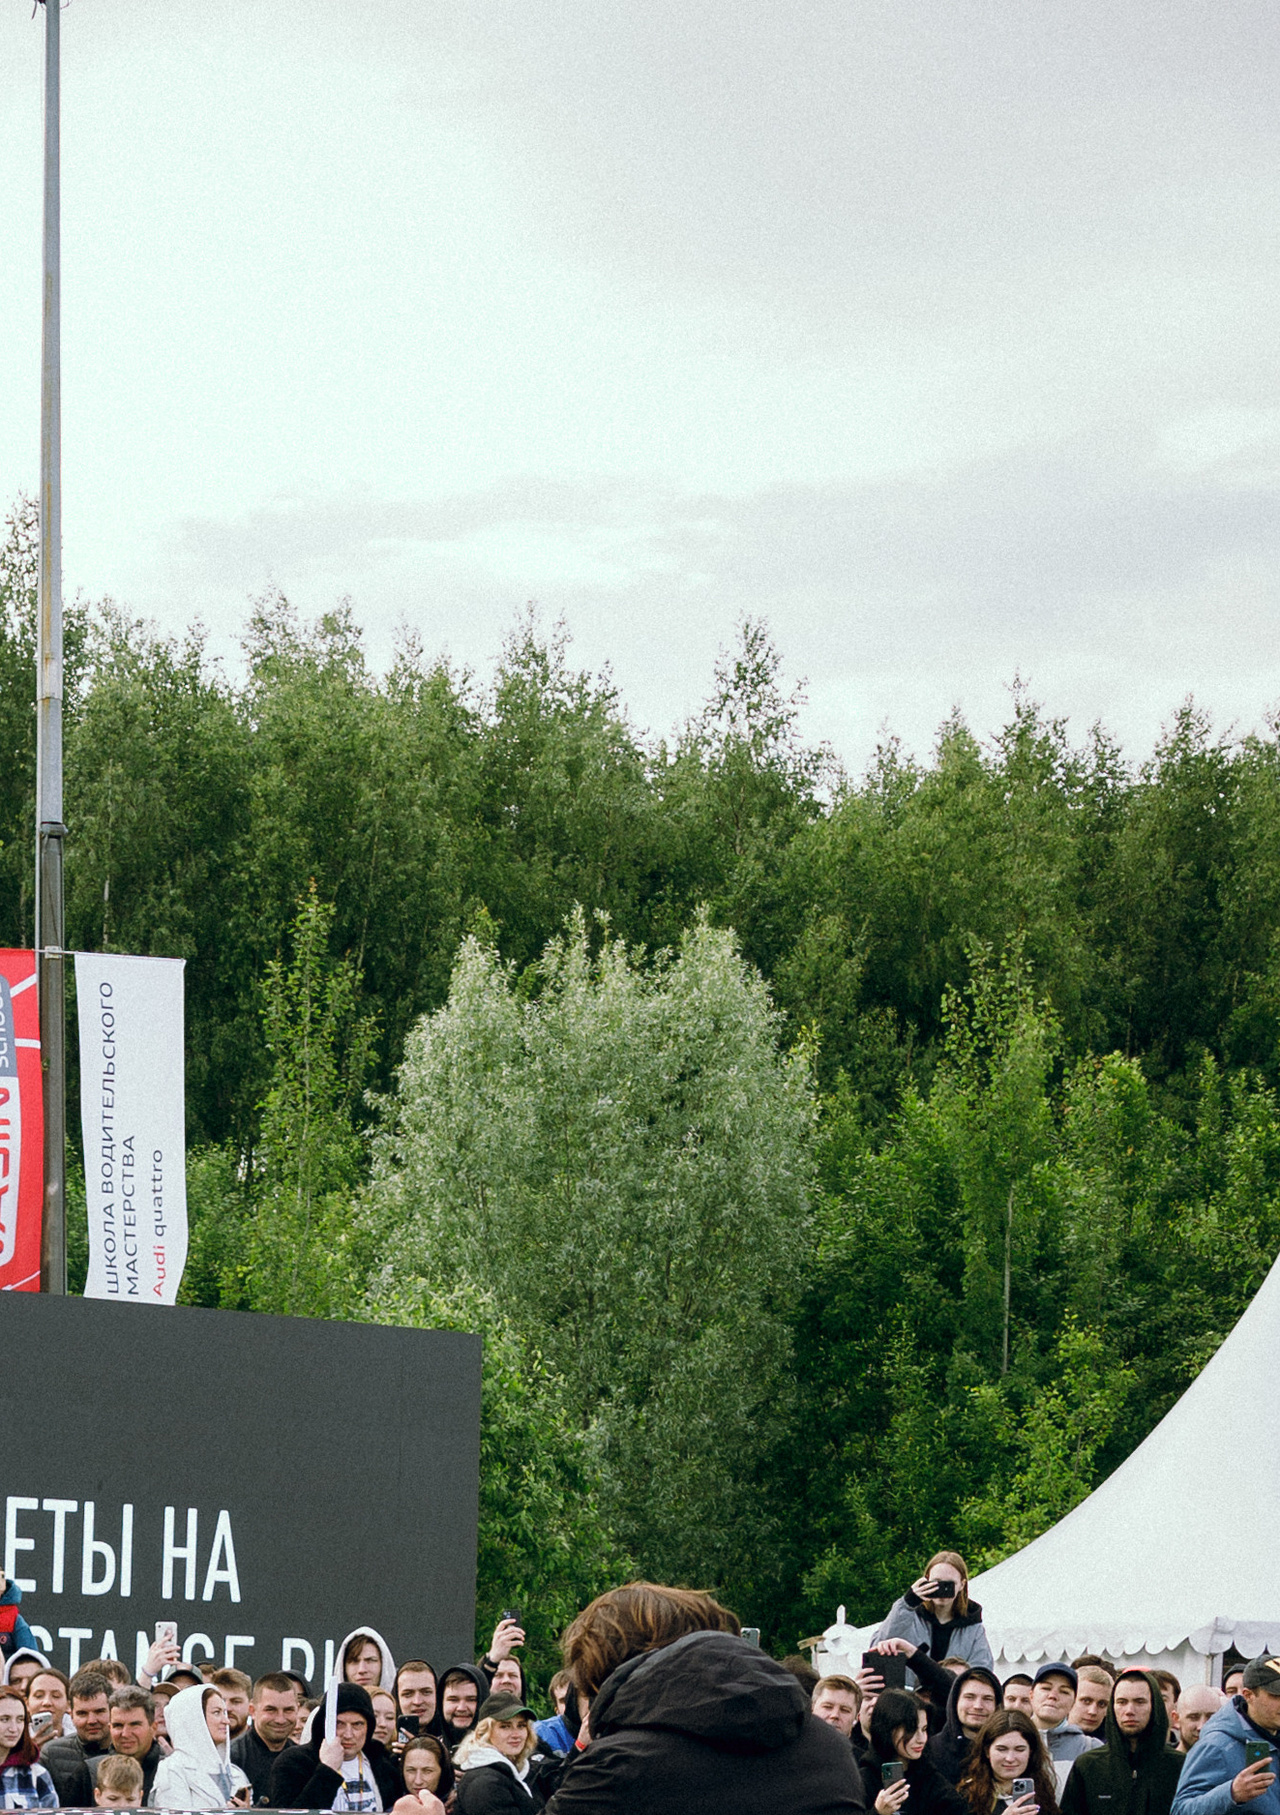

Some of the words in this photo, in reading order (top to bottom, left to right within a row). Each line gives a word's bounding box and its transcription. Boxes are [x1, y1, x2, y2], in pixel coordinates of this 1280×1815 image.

[99, 982, 116, 1194] ВОДИТЕЛЬСКОГО
[122, 1135, 139, 1295] МАСТЕРСТВА
[152, 1150, 167, 1237] quattro
[103, 1202, 119, 1294] ШКОЛА
[152, 1246, 165, 1297] Audi
[161, 1505, 242, 1603] НА
